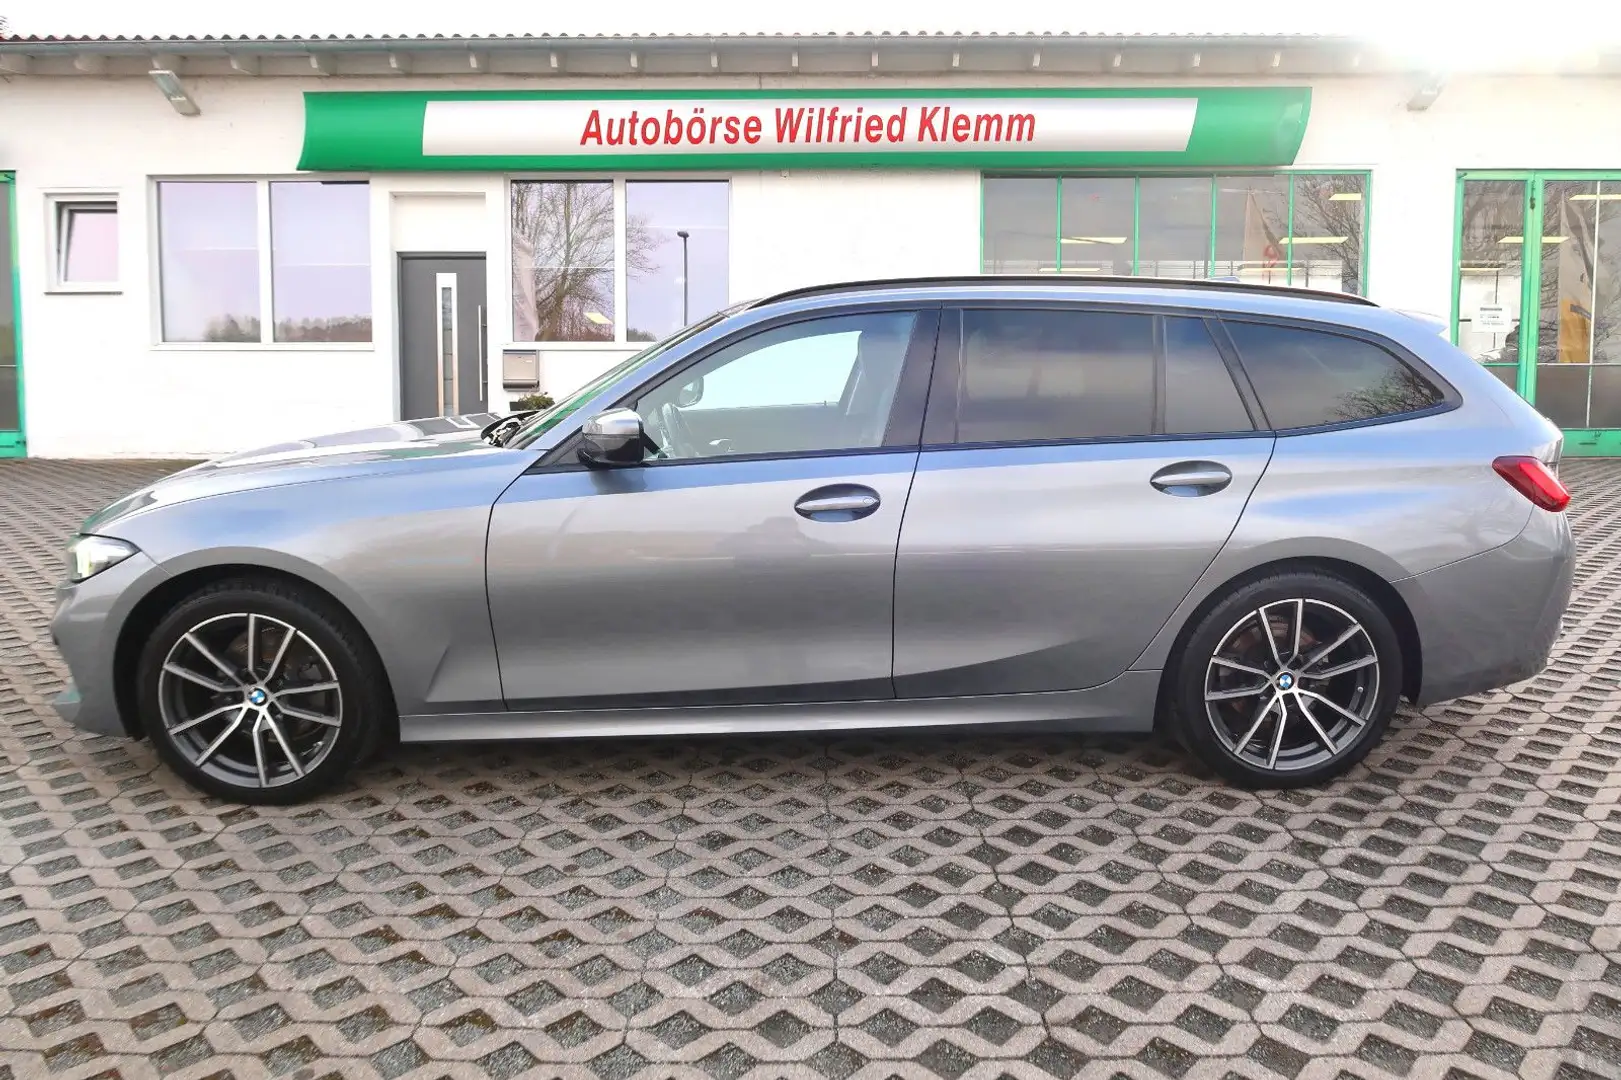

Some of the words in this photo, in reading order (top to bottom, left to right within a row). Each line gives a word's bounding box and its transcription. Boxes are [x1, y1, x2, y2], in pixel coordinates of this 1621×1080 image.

[580, 108, 762, 146] Autobörse
[775, 107, 908, 144] Wilfried
[917, 106, 1036, 143] Klemm
